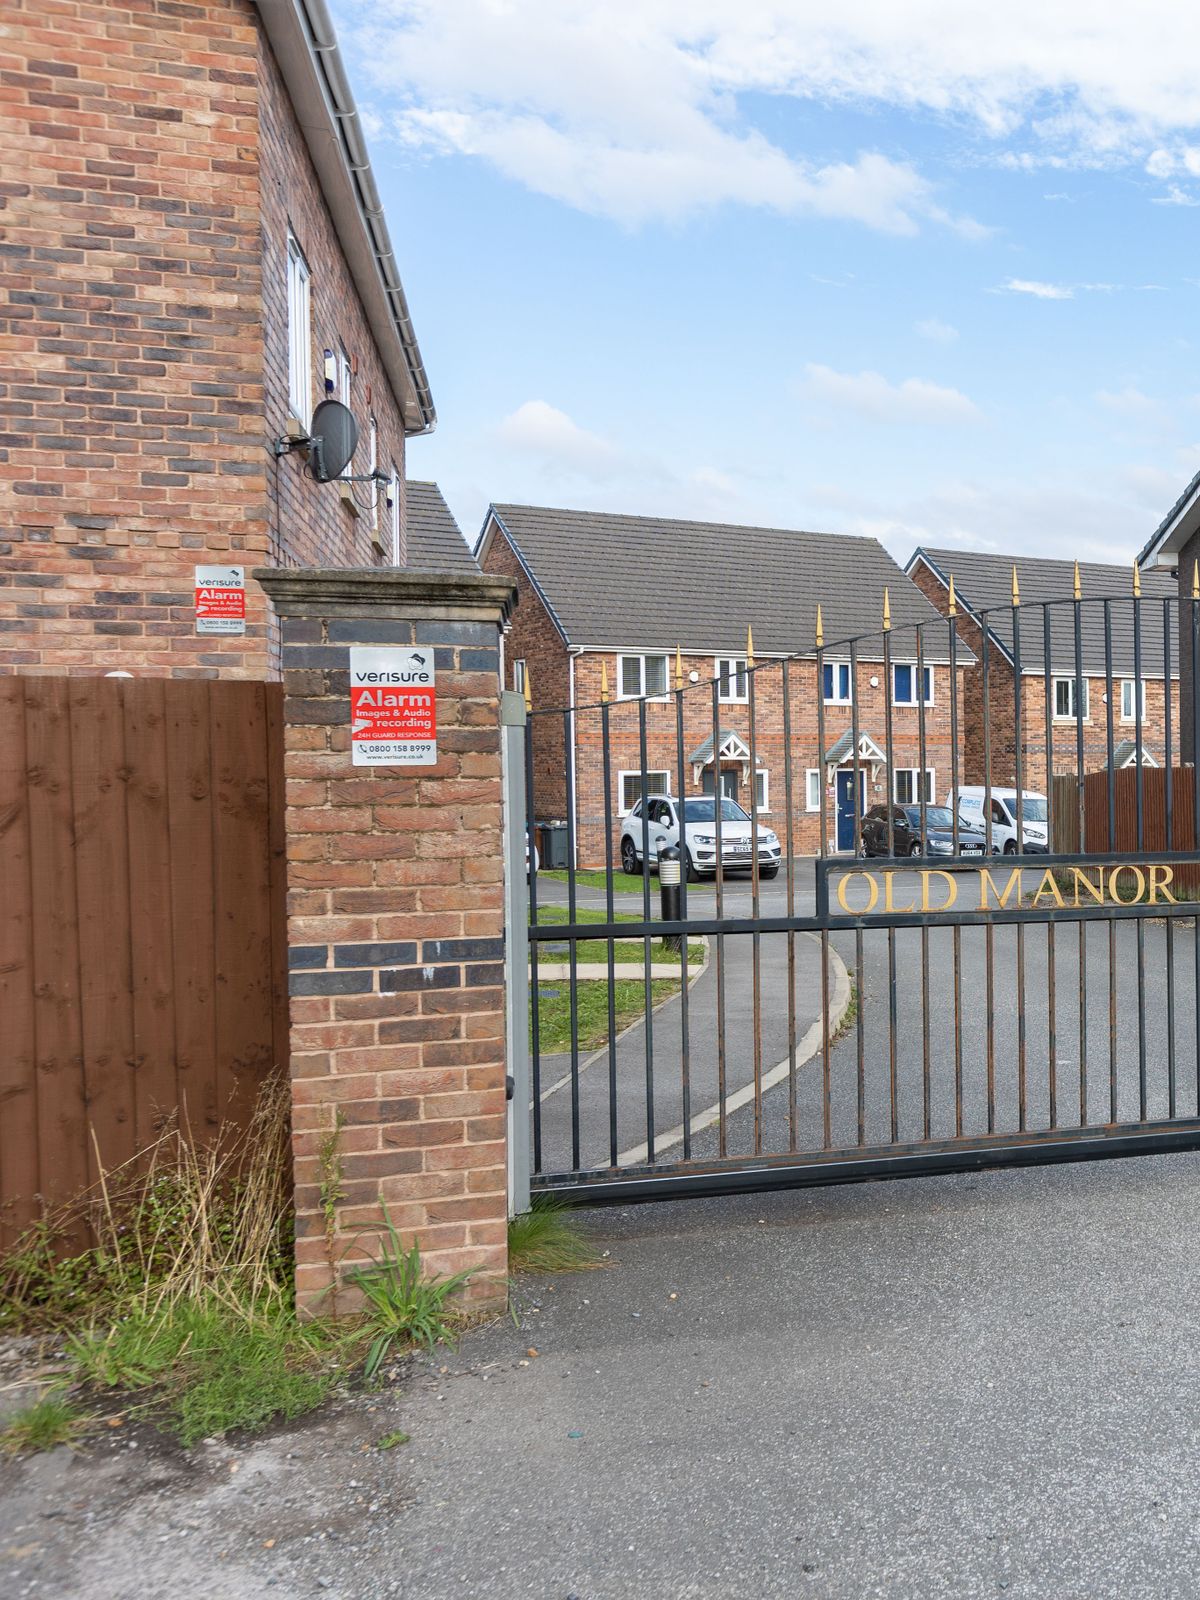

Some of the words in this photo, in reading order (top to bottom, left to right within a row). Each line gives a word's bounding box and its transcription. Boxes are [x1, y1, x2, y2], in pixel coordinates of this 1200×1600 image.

[199, 579, 241, 587] verisure
[199, 589, 243, 600] Alarm
[356, 672, 429, 682] verisure
[356, 690, 431, 707] Alarm
[356, 709, 390, 718] Images
[403, 709, 431, 717] Audio
[377, 718, 432, 729] recording
[410, 744, 431, 752] 8999
[837, 870, 958, 915] OLD
[976, 865, 1181, 911] MANOR
